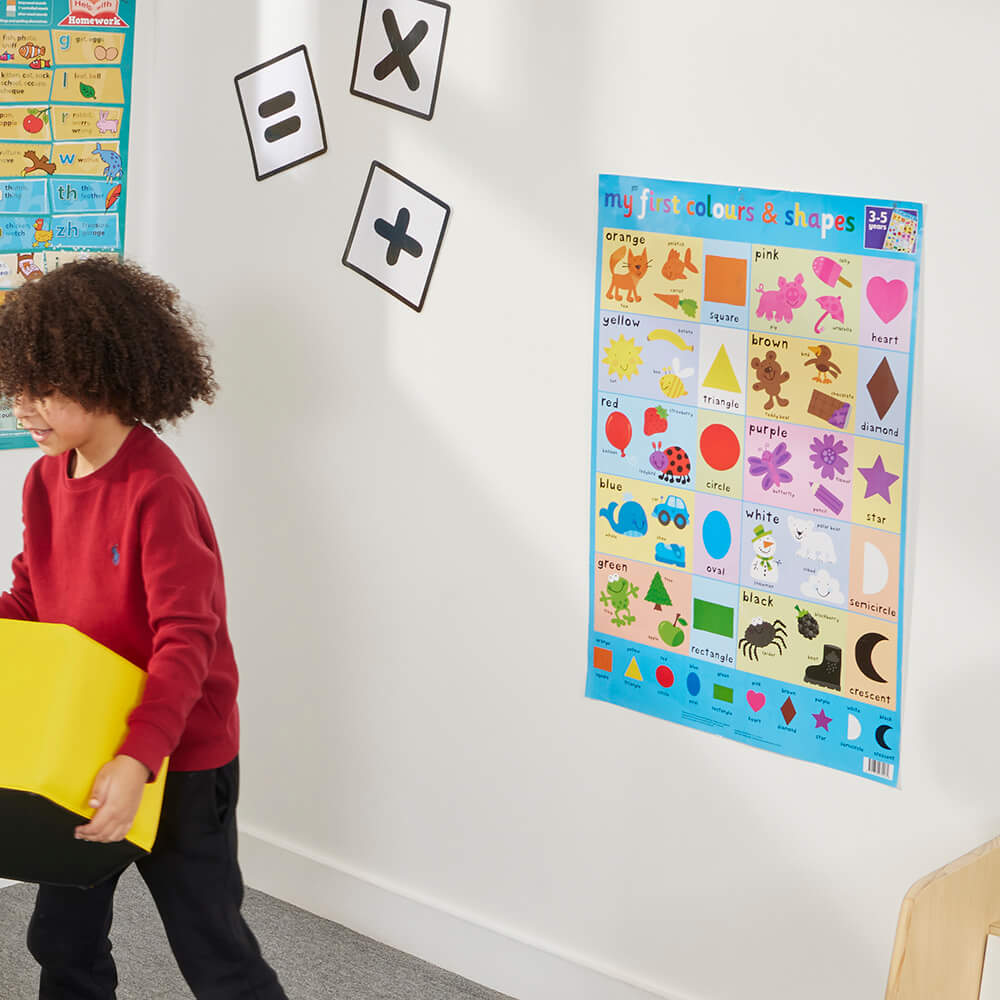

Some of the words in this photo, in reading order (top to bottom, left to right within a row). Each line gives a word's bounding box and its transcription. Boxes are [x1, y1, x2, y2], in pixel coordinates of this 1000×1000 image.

[68, 16, 121, 25] Homework
[59, 35, 70, 50] g
[62, 72, 68, 88] l
[62, 112, 69, 123] r
[59, 153, 75, 165] w
[58, 184, 77, 200] th
[604, 192, 633, 218] my
[637, 188, 680, 219] first
[686, 194, 755, 222] colours
[762, 202, 778, 225] &
[784, 202, 855, 239] shapes
[868, 210, 888, 223] 3-5
[56, 221, 78, 238] zh
[605, 232, 645, 246] orange
[755, 248, 779, 262] pink
[602, 314, 641, 327] yellow
[709, 311, 740, 323] square
[751, 334, 788, 349] brown
[871, 332, 900, 345] heart
[601, 397, 619, 408] red
[703, 395, 739, 410] triangle
[749, 424, 788, 439] purple
[861, 422, 899, 437] diamond
[600, 478, 622, 491] blue
[706, 481, 731, 492] circle
[745, 509, 780, 524] white
[867, 512, 886, 524] star
[597, 559, 628, 572] green
[706, 565, 725, 576] oval
[743, 591, 774, 607] black
[850, 599, 896, 617] semicircle
[691, 646, 734, 664] rectangle
[849, 687, 891, 704] crescent
